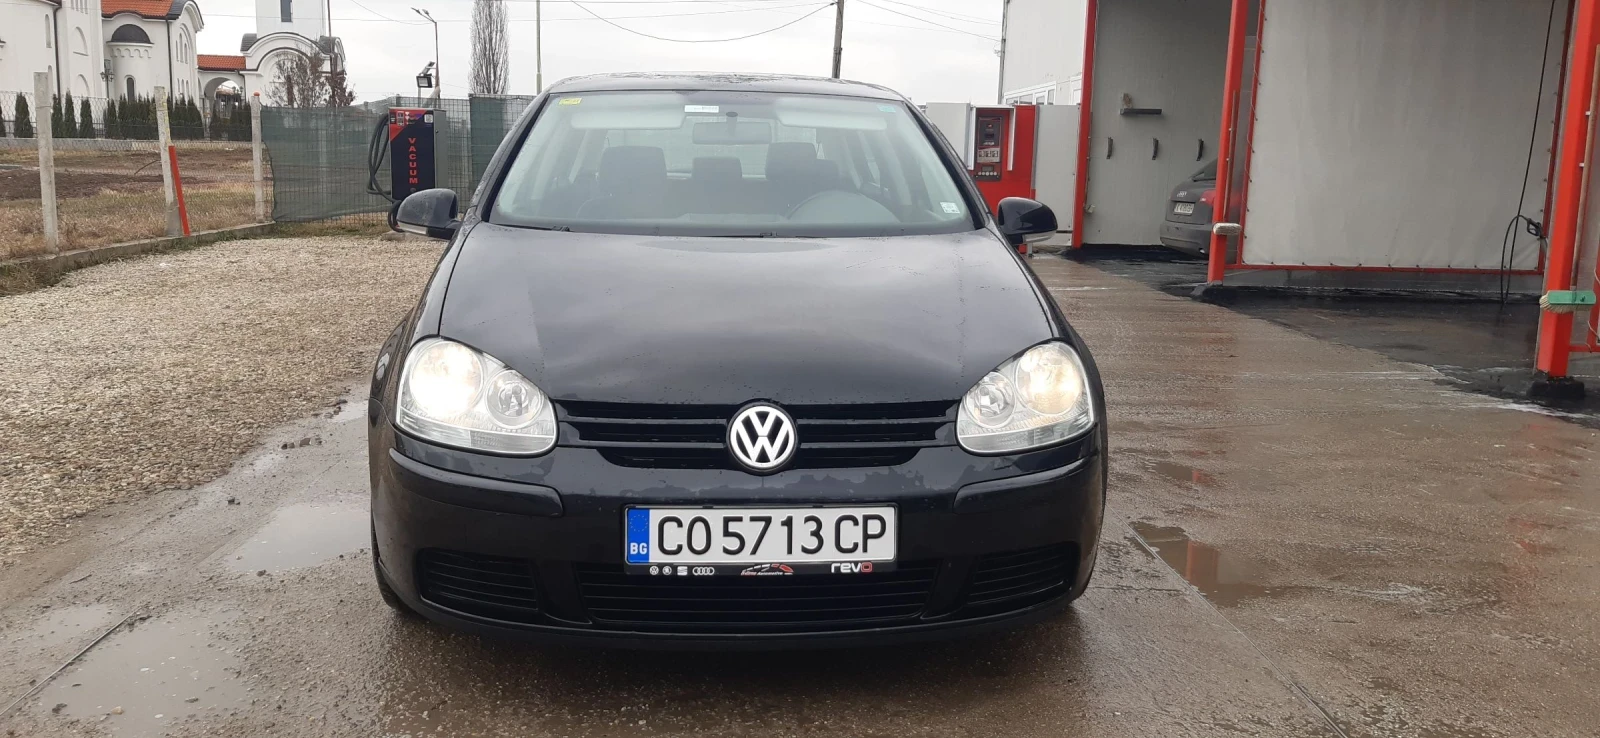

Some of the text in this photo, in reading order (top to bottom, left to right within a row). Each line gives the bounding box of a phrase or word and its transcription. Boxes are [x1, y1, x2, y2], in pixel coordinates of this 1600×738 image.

[408, 137, 418, 184] VACUUM
[731, 407, 794, 468] VW
[630, 543, 648, 555] BG
[722, 514, 824, 556] 5713
[834, 514, 886, 554] CP
